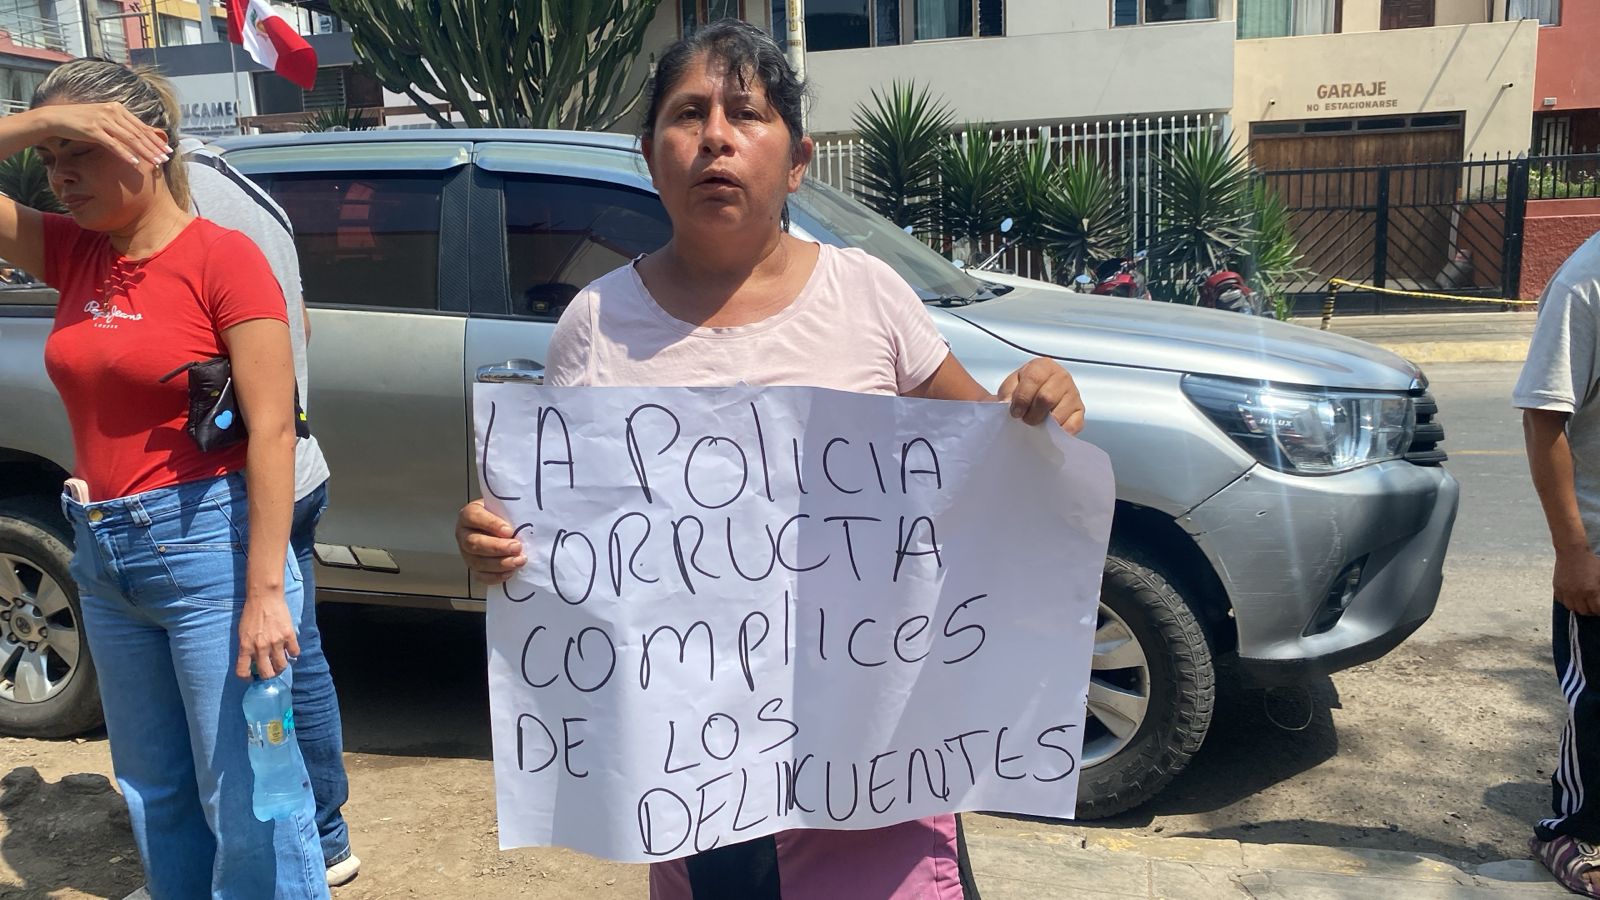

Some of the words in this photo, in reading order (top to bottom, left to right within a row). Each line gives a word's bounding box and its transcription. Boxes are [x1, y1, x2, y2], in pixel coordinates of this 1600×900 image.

[1316, 81, 1386, 99] GARAJE
[1306, 103, 1319, 112] NO
[1324, 99, 1398, 110] ESTACIONARSE
[1260, 418, 1293, 427] HILUX
[483, 401, 575, 510] LA
[515, 712, 589, 778] DE
[663, 698, 799, 774] LOS
